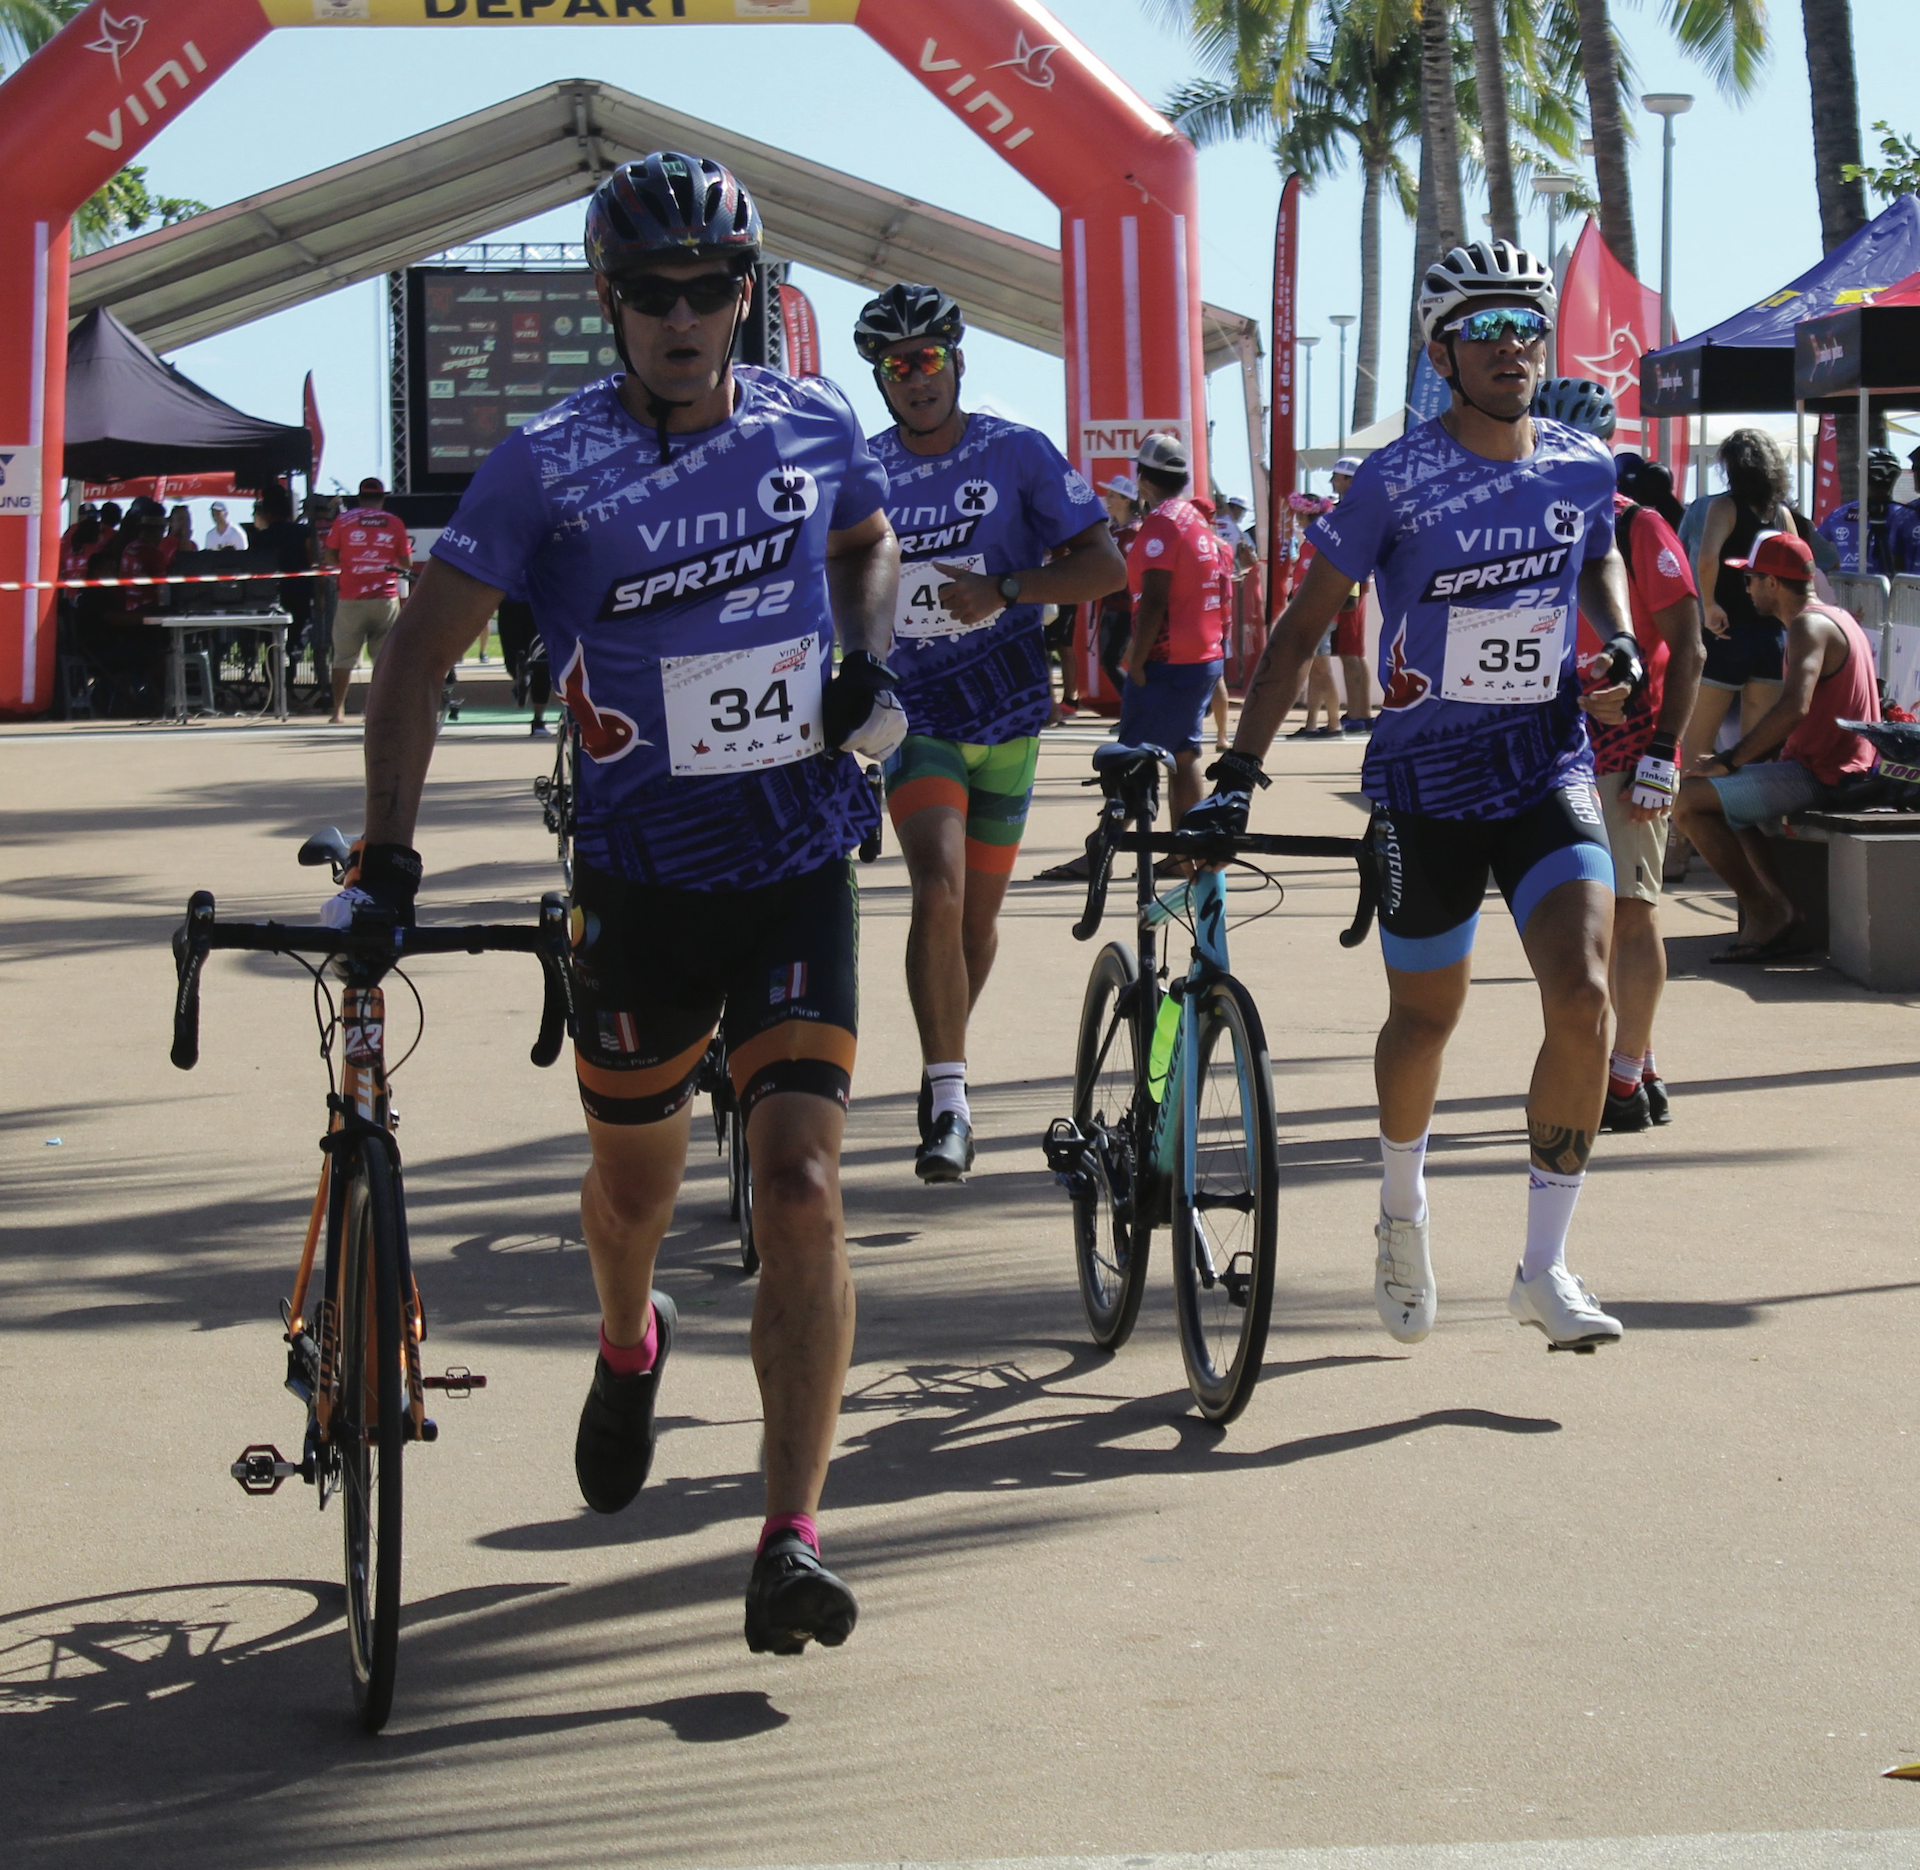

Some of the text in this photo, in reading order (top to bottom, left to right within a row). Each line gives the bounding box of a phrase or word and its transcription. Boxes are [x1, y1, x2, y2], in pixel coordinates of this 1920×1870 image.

[85, 40, 208, 151] VINI
[919, 37, 1035, 150] VINI
[637, 507, 746, 552] VINI
[898, 520, 975, 554] RINT
[1456, 526, 1536, 552] VINI
[612, 528, 795, 613] SPRINT
[1431, 548, 1568, 597] SPRINT
[719, 580, 795, 624] 22
[911, 582, 956, 611] 4
[1509, 586, 1560, 610] 22
[793, 662, 806, 673] 22
[1478, 638, 1541, 673] 35
[709, 679, 794, 733] 34
[790, 1006, 821, 1018] Pirae
